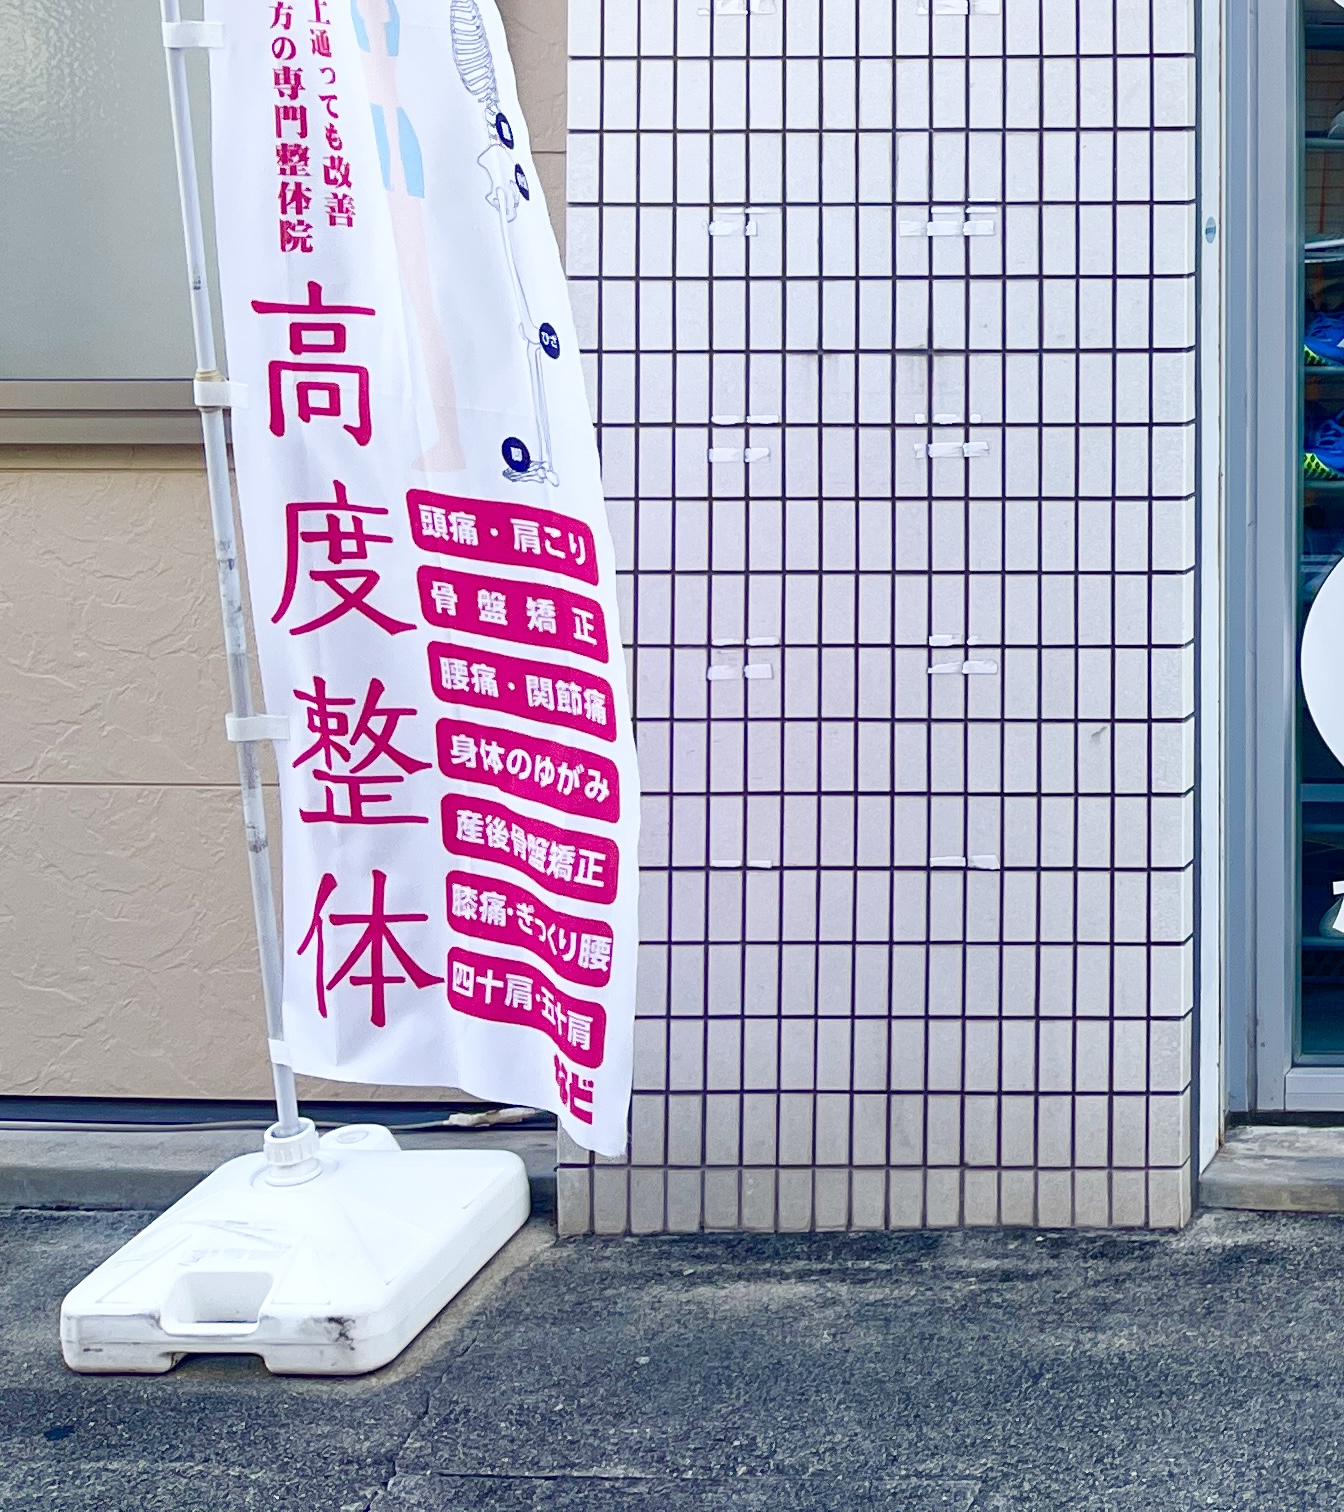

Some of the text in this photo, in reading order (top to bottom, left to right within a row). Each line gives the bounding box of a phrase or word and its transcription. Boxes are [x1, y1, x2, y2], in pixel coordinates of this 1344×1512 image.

[417, 502, 588, 566] 頭痛・肩こり
[250, 279, 446, 1028] 高度整体
[439, 656, 608, 726] 腰痛・関節痛
[449, 733, 610, 803] 身体のゆがみ
[455, 808, 608, 889] 産後骨盤矯正
[451, 881, 612, 973] 膝痛・ぎっくり腰
